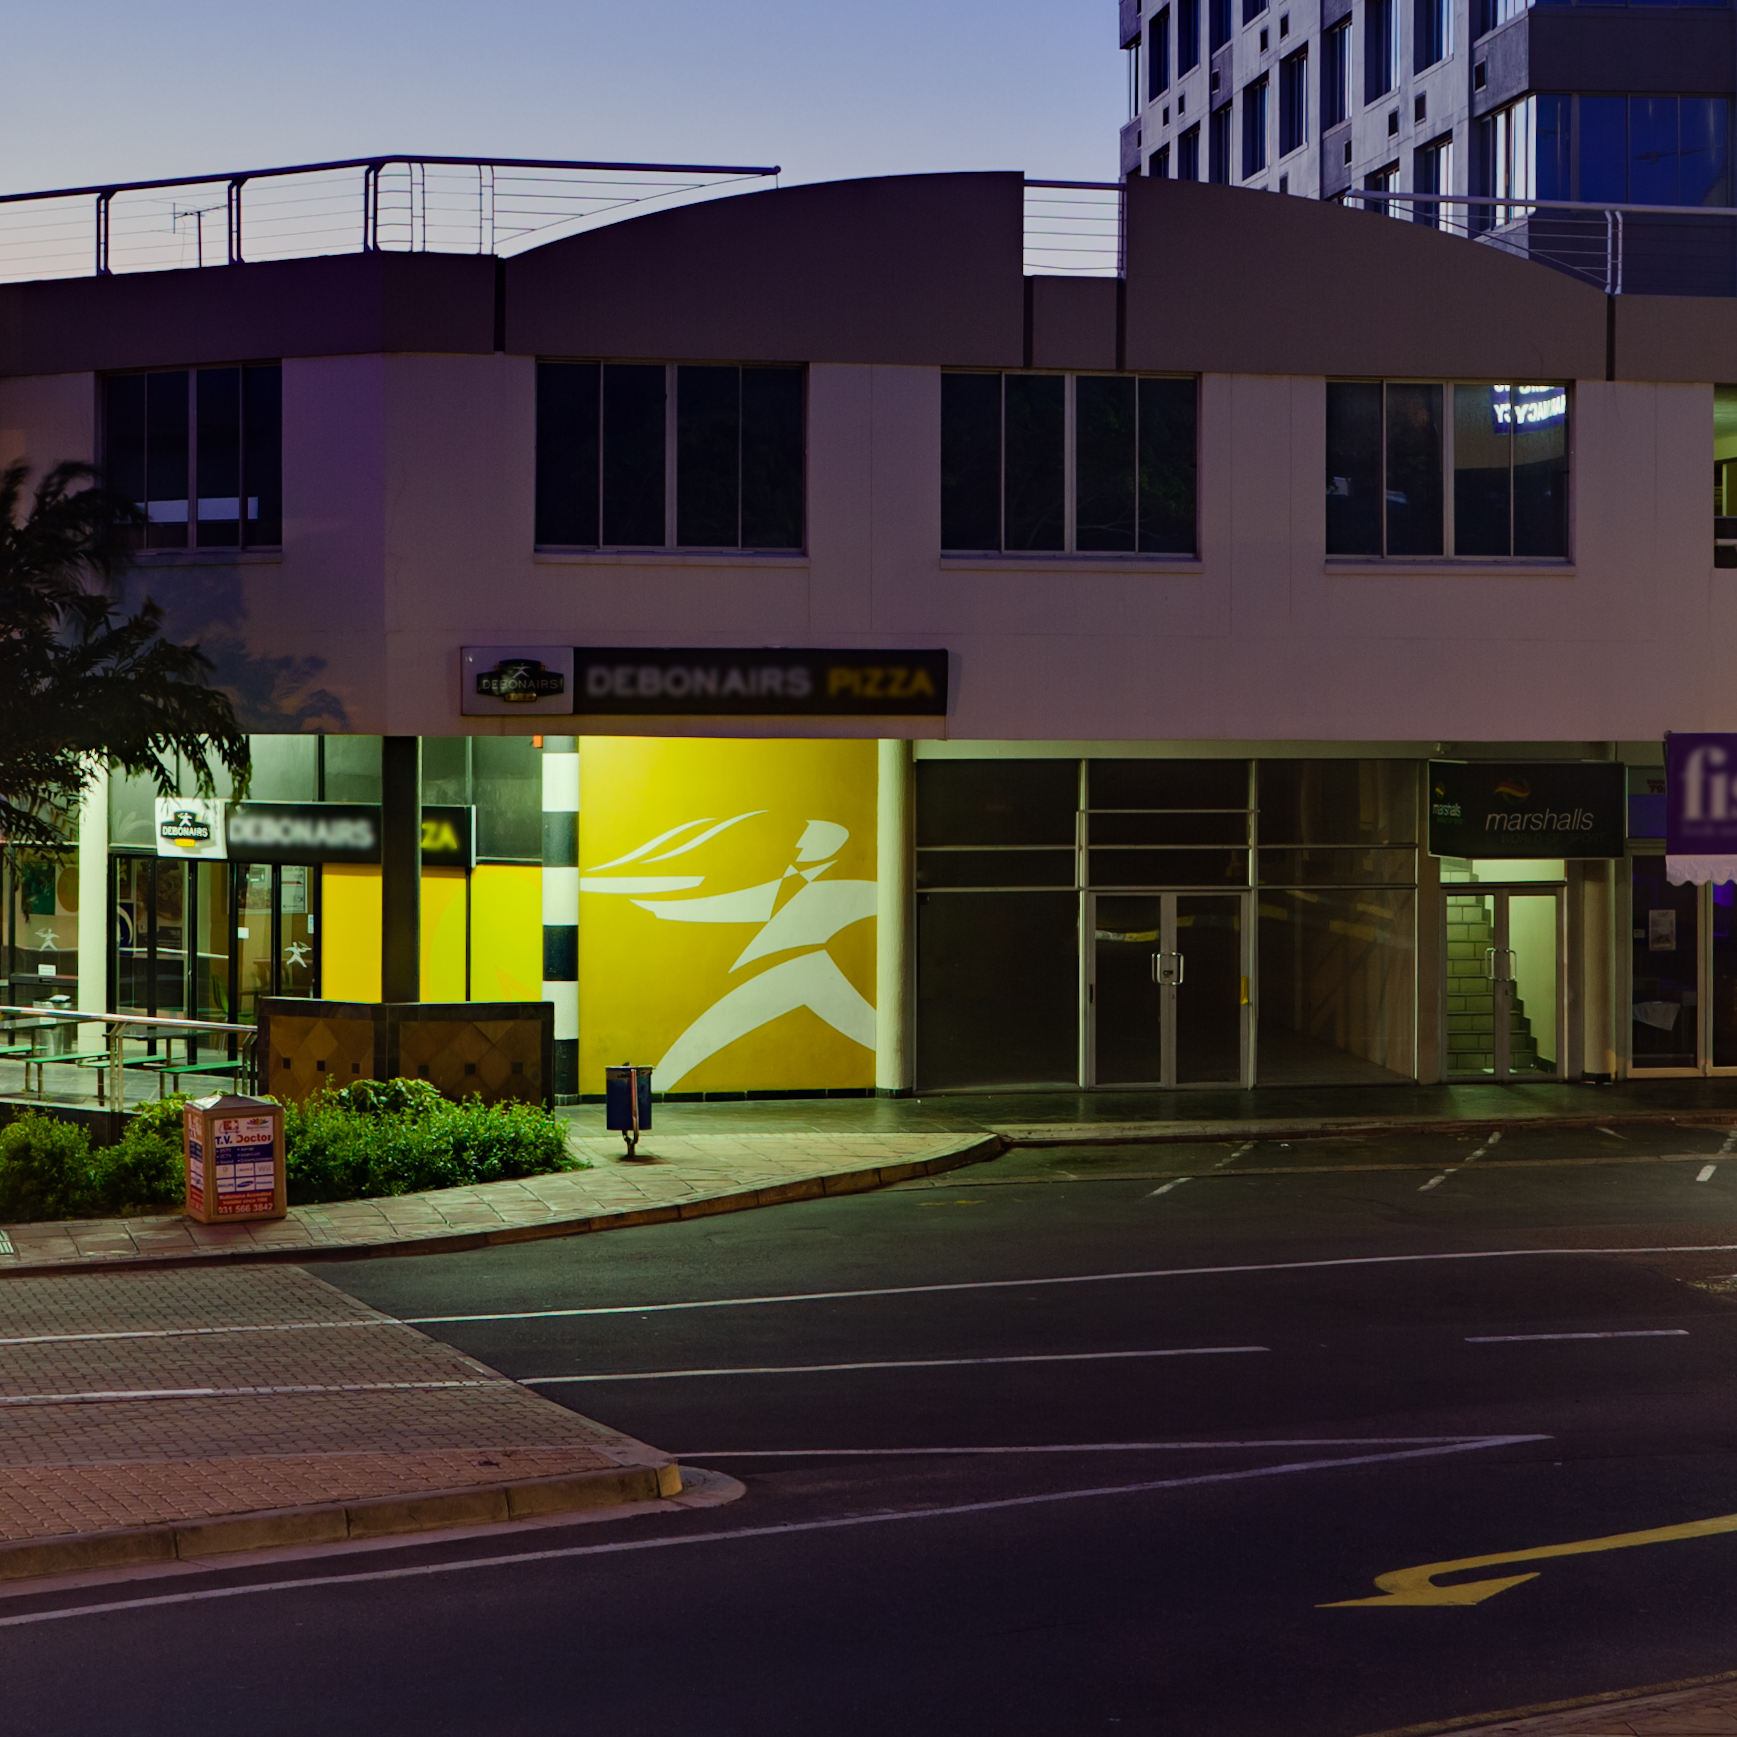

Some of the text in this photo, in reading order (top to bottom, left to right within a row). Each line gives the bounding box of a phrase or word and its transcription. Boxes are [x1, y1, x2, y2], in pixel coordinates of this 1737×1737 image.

[482, 679, 558, 689] DEBONAIRS
[1485, 808, 1594, 831] marshalls
[162, 826, 208, 837] DEBONAIRS
[215, 1133, 271, 1145] T.V. Doctor
